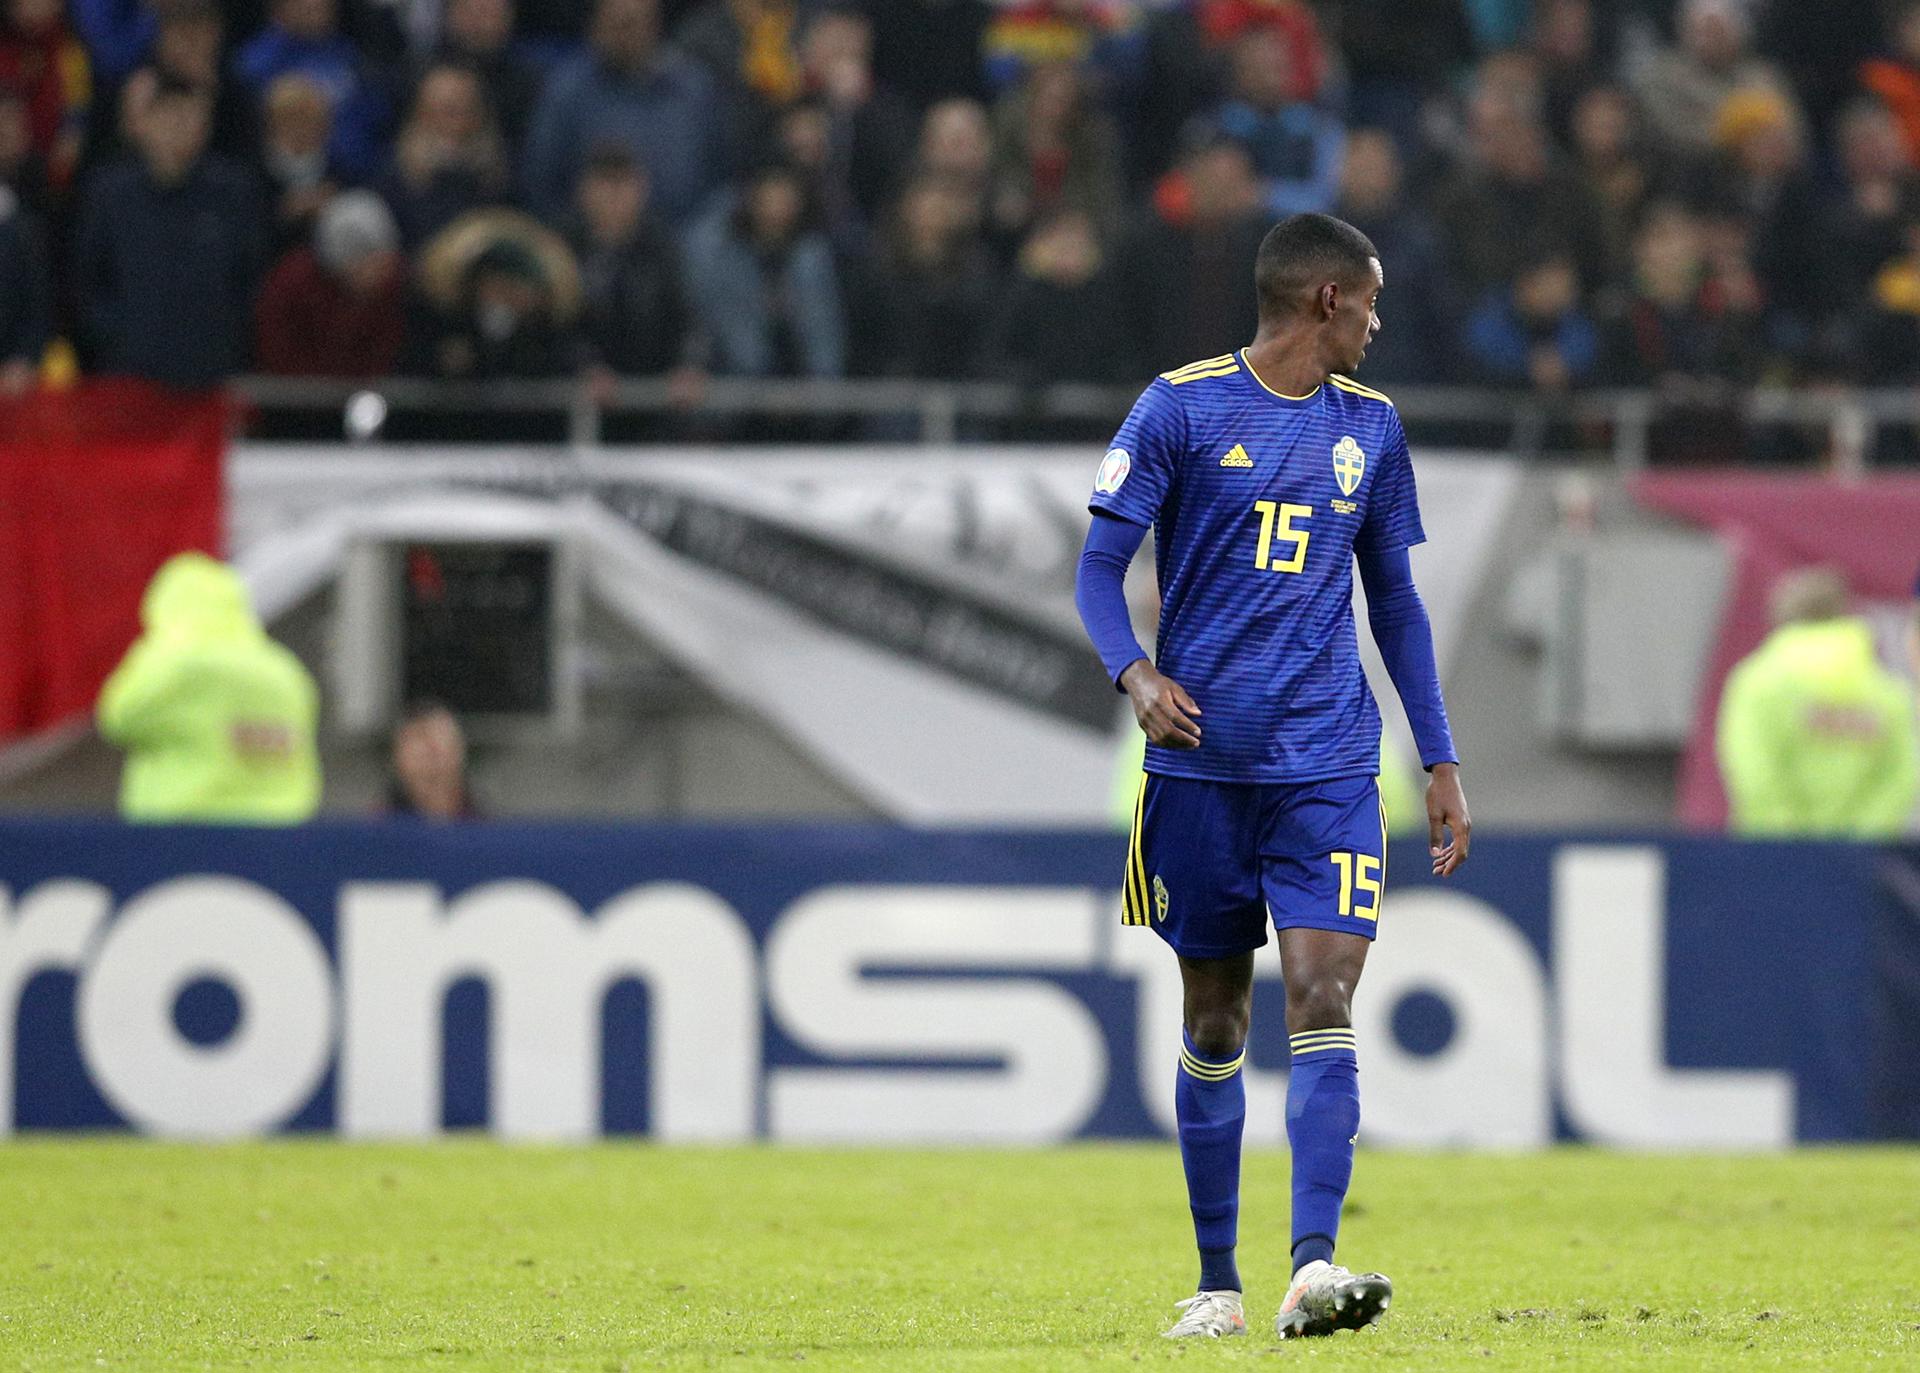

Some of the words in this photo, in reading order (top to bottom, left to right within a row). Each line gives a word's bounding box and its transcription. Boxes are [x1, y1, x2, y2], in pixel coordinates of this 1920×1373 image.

[1220, 458, 1254, 467] adidas
[1254, 500, 1313, 574] 15
[1330, 852, 1381, 922] 15
